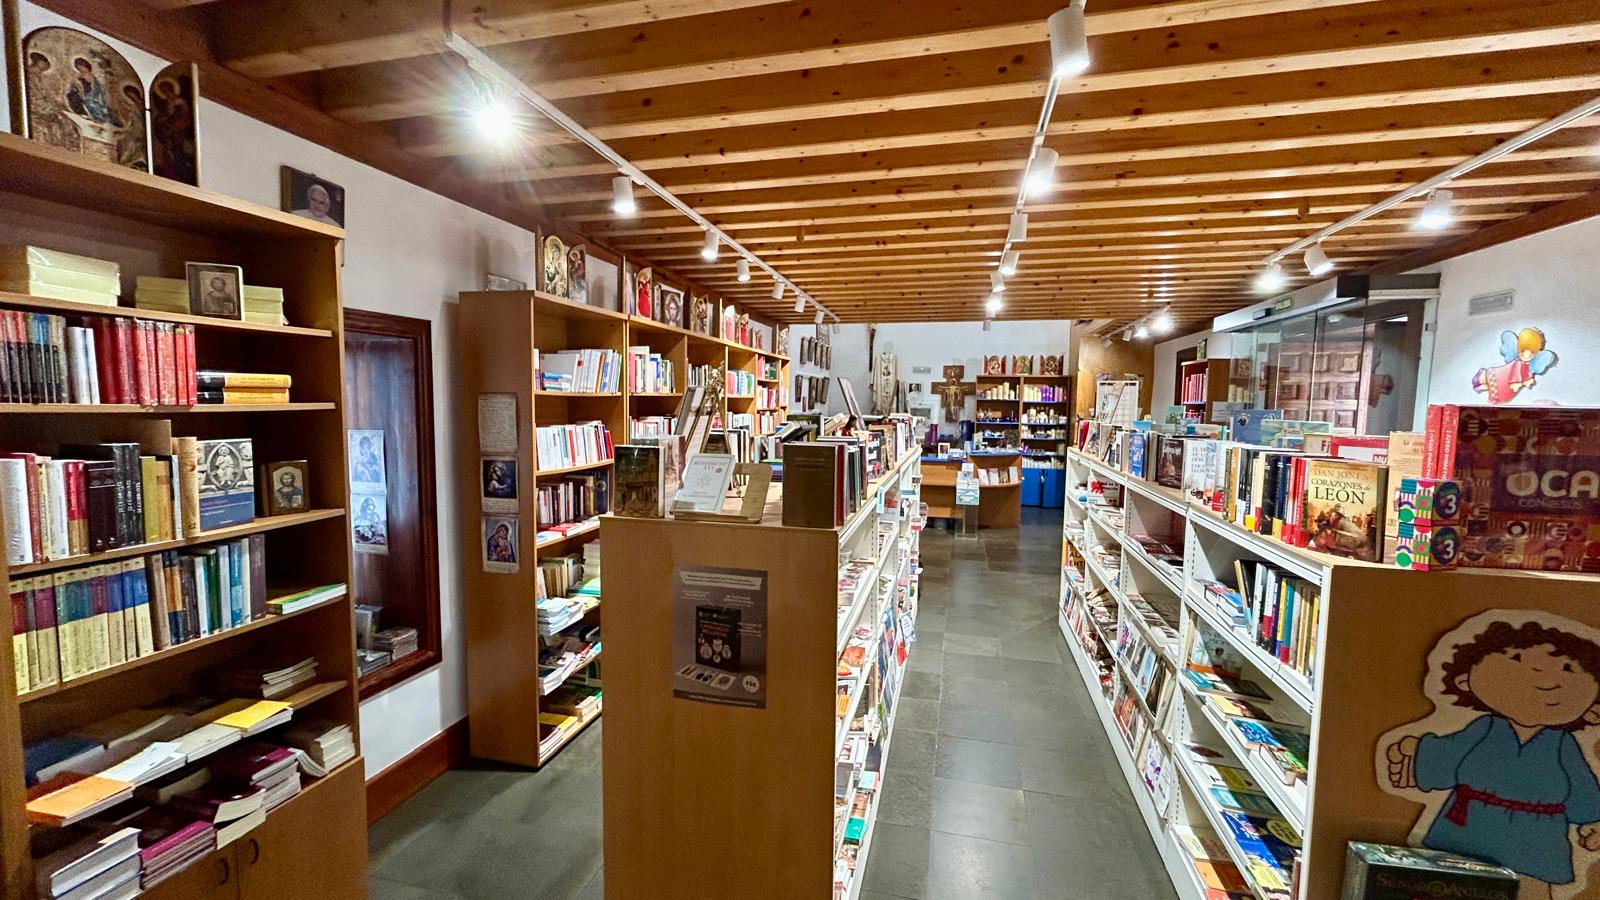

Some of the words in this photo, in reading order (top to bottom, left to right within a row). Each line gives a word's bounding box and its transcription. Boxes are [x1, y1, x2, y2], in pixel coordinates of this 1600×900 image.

[1311, 478, 1362, 490] CORAZONES
[1313, 468, 1334, 477] DAN
[1337, 469, 1369, 480] JONES
[1506, 469, 1599, 498] OCA
[1445, 494, 1457, 514] 3
[1443, 539, 1454, 559] 3
